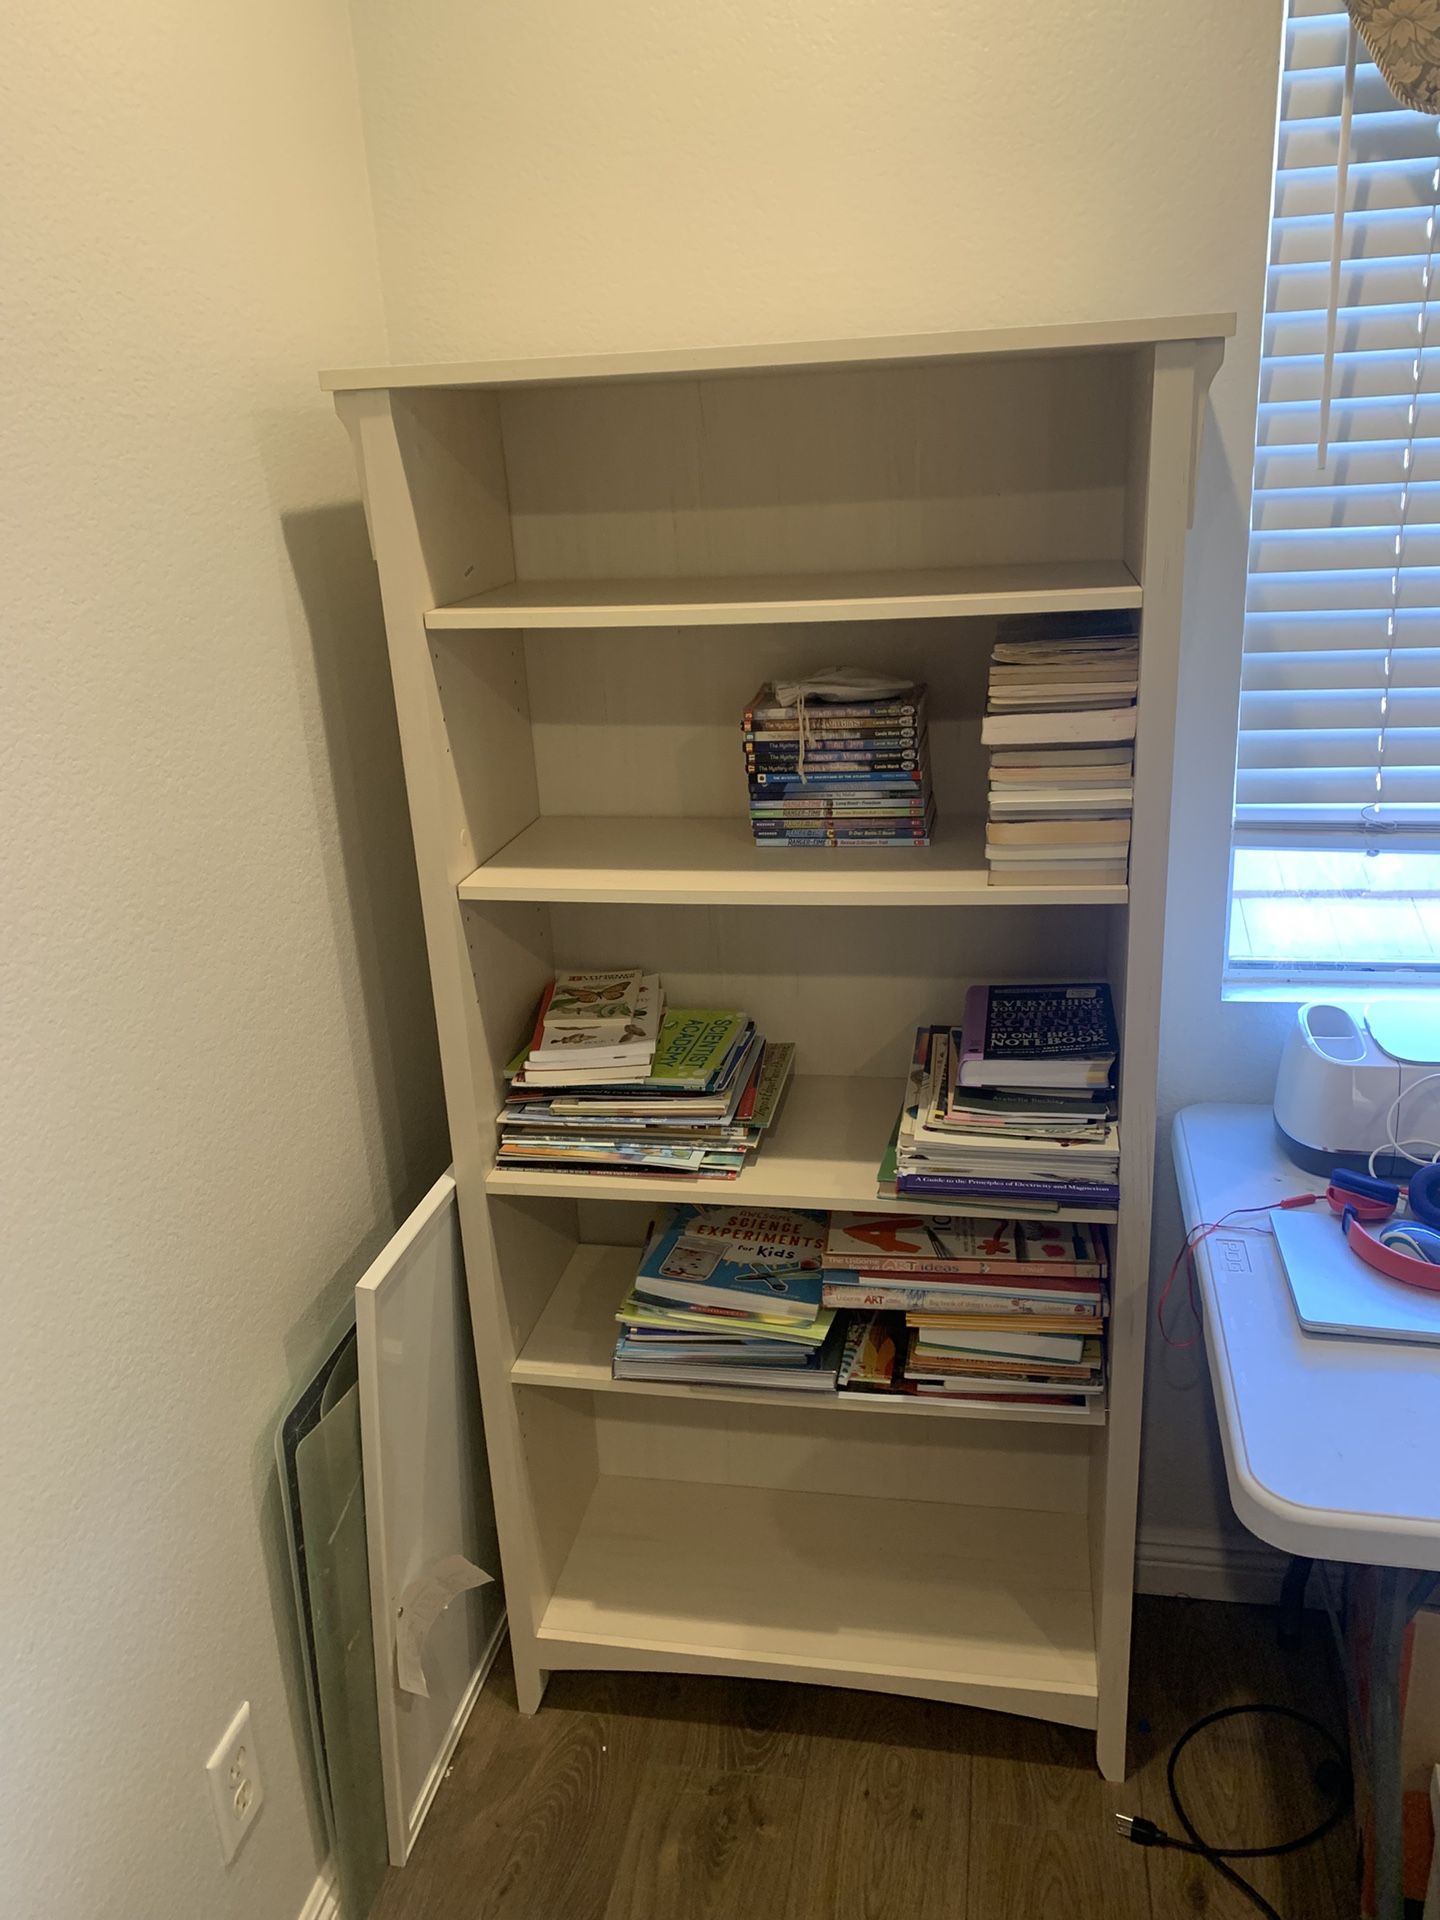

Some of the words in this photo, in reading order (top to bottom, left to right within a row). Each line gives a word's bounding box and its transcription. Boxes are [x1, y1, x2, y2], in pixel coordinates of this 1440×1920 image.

[992, 998, 1104, 1007] EVERYTHING
[657, 1019, 704, 1067] ACADEMY
[686, 1019, 732, 1068] SCIENTIST
[991, 1035, 1108, 1046] NOTEBOOK
[728, 1216, 803, 1234] SCIENCE
[697, 1224, 824, 1249] EXPERIMENTS
[757, 1246, 796, 1259] Kids
[920, 1263, 960, 1272] ideas
[864, 1295, 885, 1304] ART
